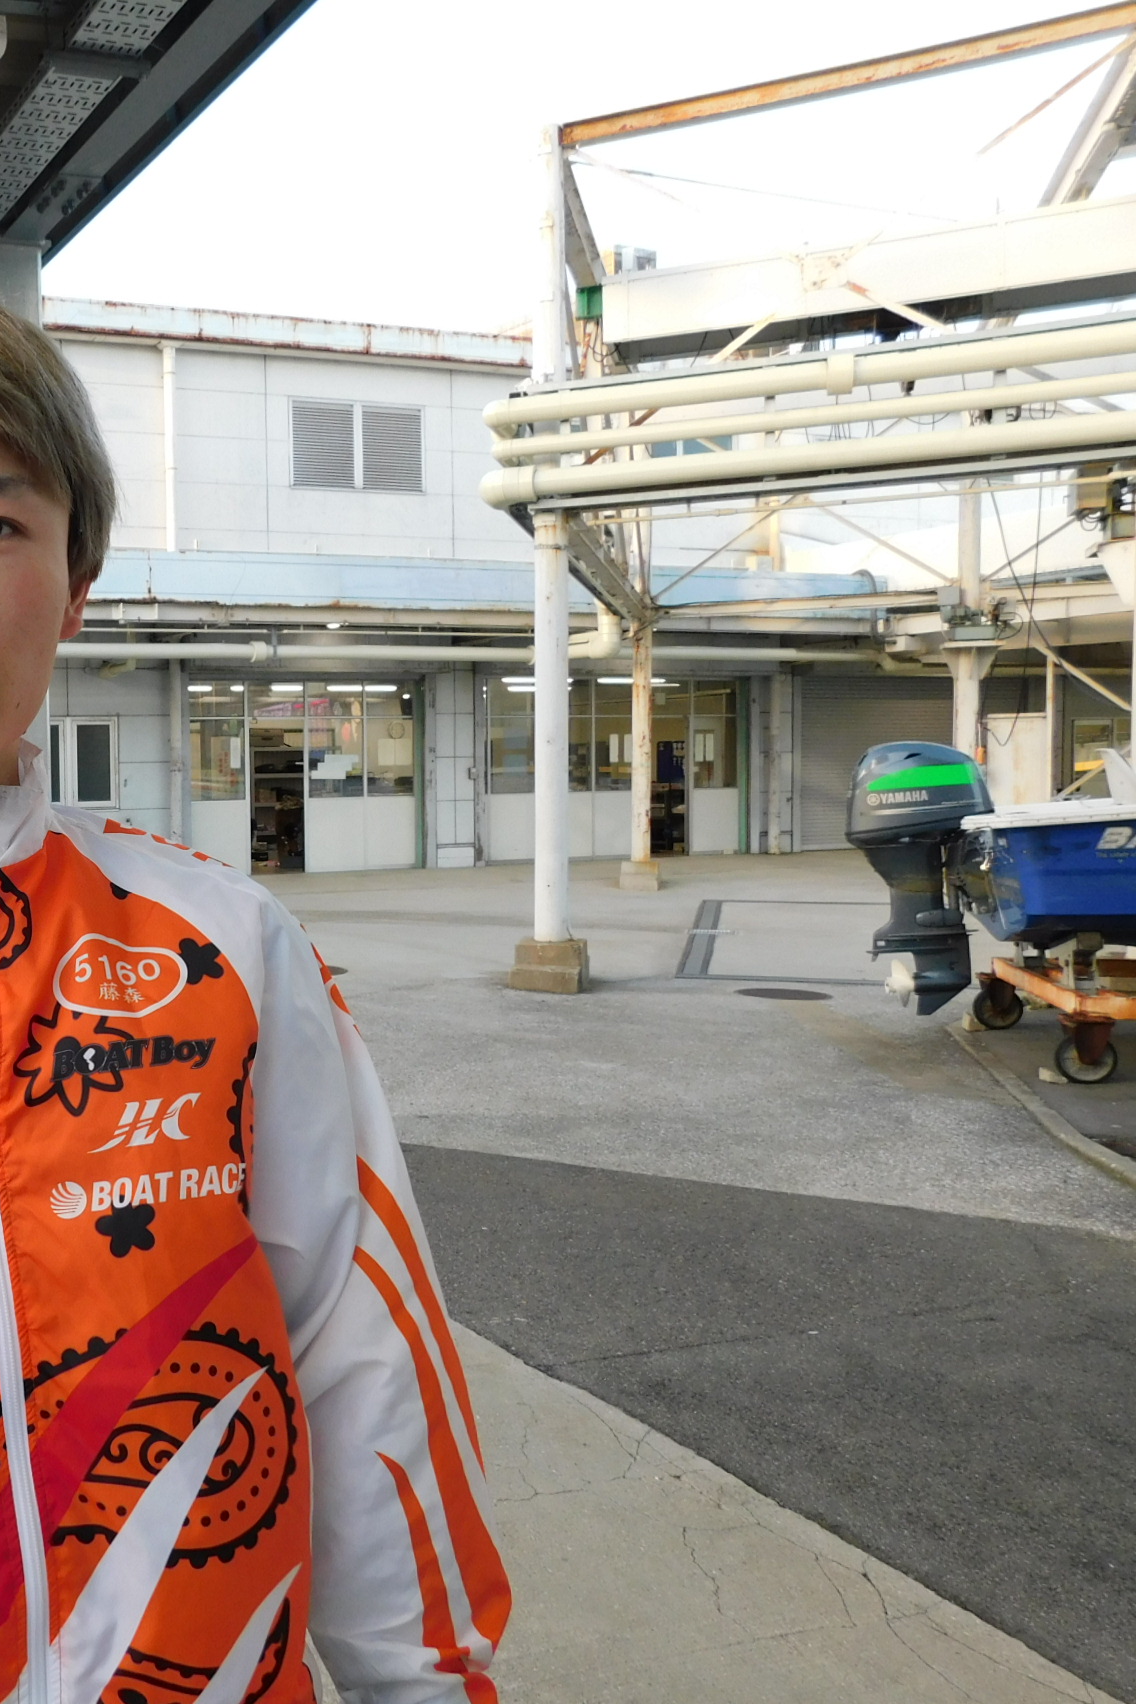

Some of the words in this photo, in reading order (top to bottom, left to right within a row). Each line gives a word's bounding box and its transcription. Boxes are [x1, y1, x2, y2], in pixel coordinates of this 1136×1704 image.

[880, 790, 929, 804] YAMAHA
[74, 953, 161, 985] 5160
[98, 982, 145, 1004] 藤森
[51, 1036, 150, 1082] BOAT
[91, 1170, 174, 1213] BOAT
[179, 1162, 246, 1201] RACE
